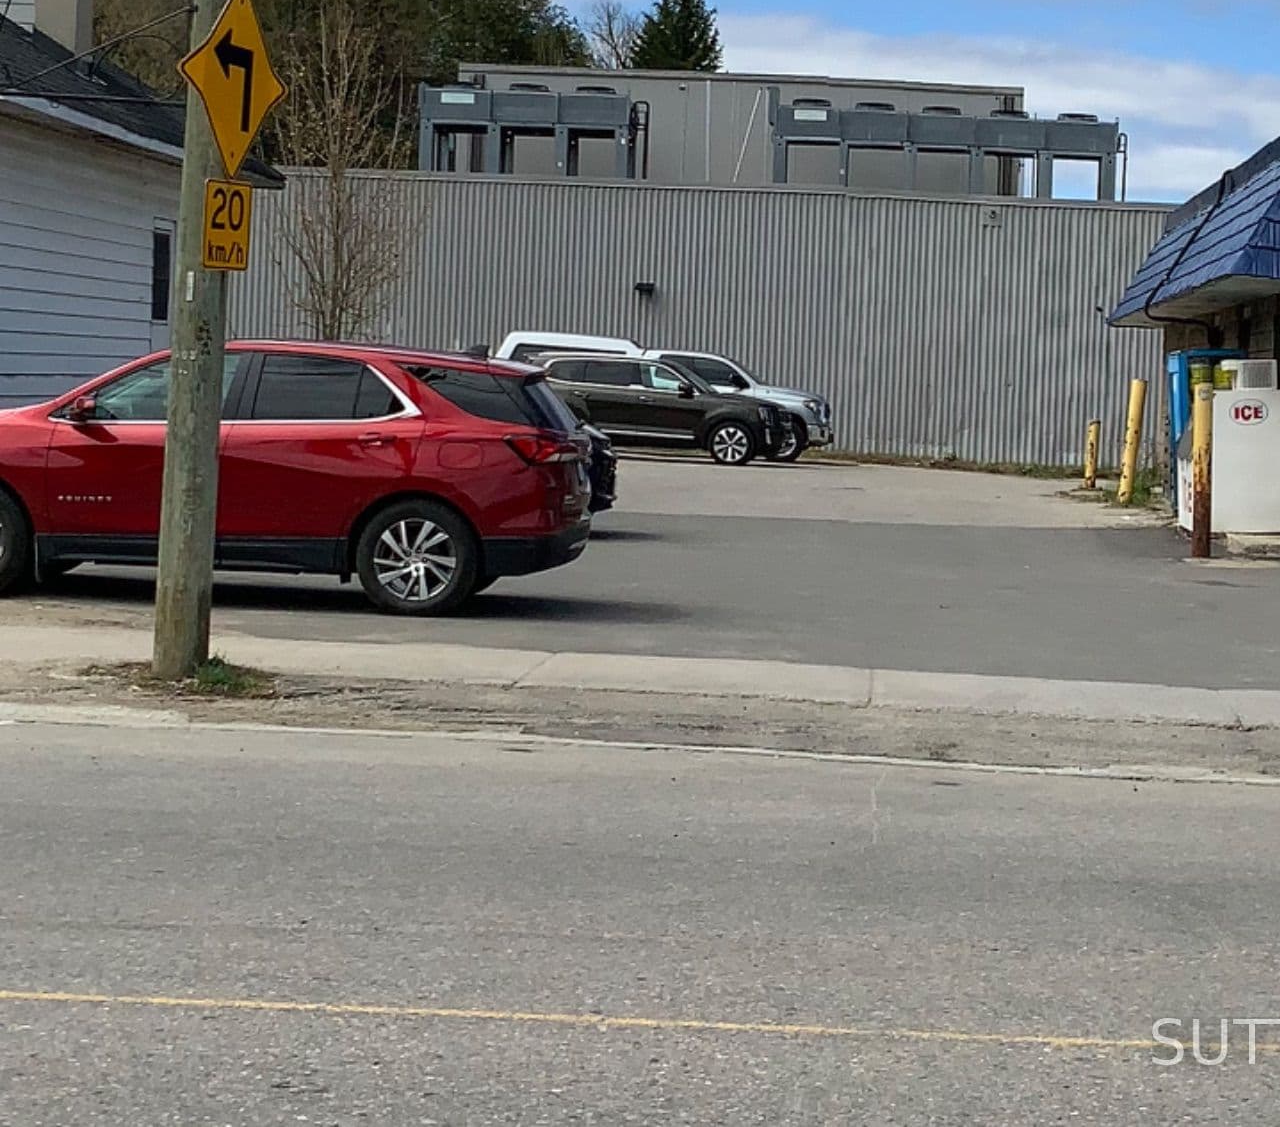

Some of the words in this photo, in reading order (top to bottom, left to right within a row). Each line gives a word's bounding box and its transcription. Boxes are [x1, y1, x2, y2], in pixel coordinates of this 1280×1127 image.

[211, 187, 244, 231] 20
[208, 240, 243, 264] km/h
[1234, 405, 1263, 421] ICE
